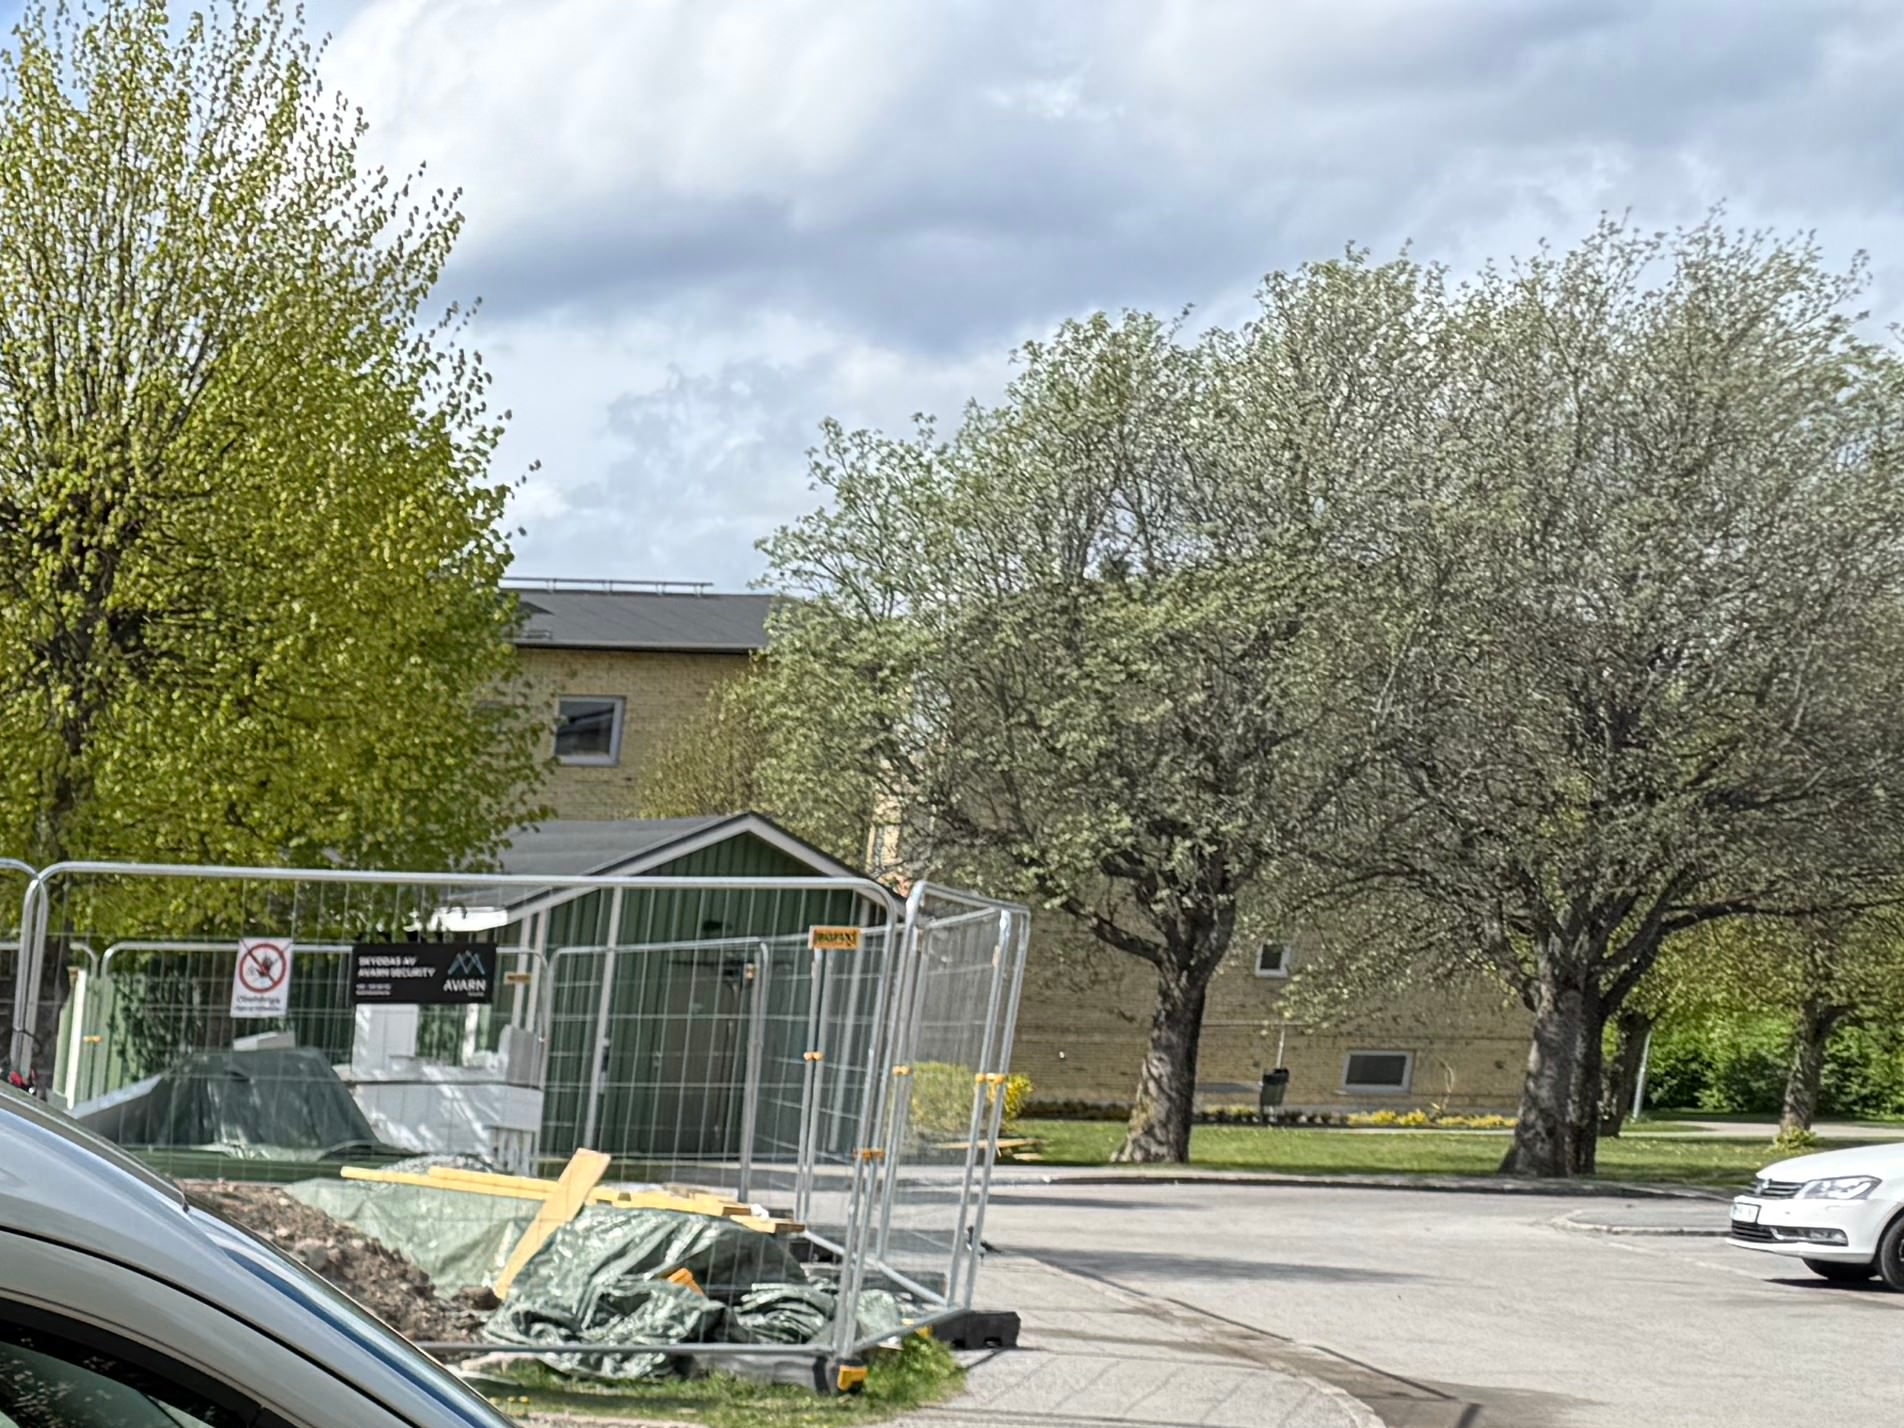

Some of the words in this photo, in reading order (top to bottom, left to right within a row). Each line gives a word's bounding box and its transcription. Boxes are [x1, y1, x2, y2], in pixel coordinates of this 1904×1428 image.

[357, 966, 390, 978] AVARN
[391, 967, 436, 978] SECURITY
[443, 978, 487, 992] AVARN
